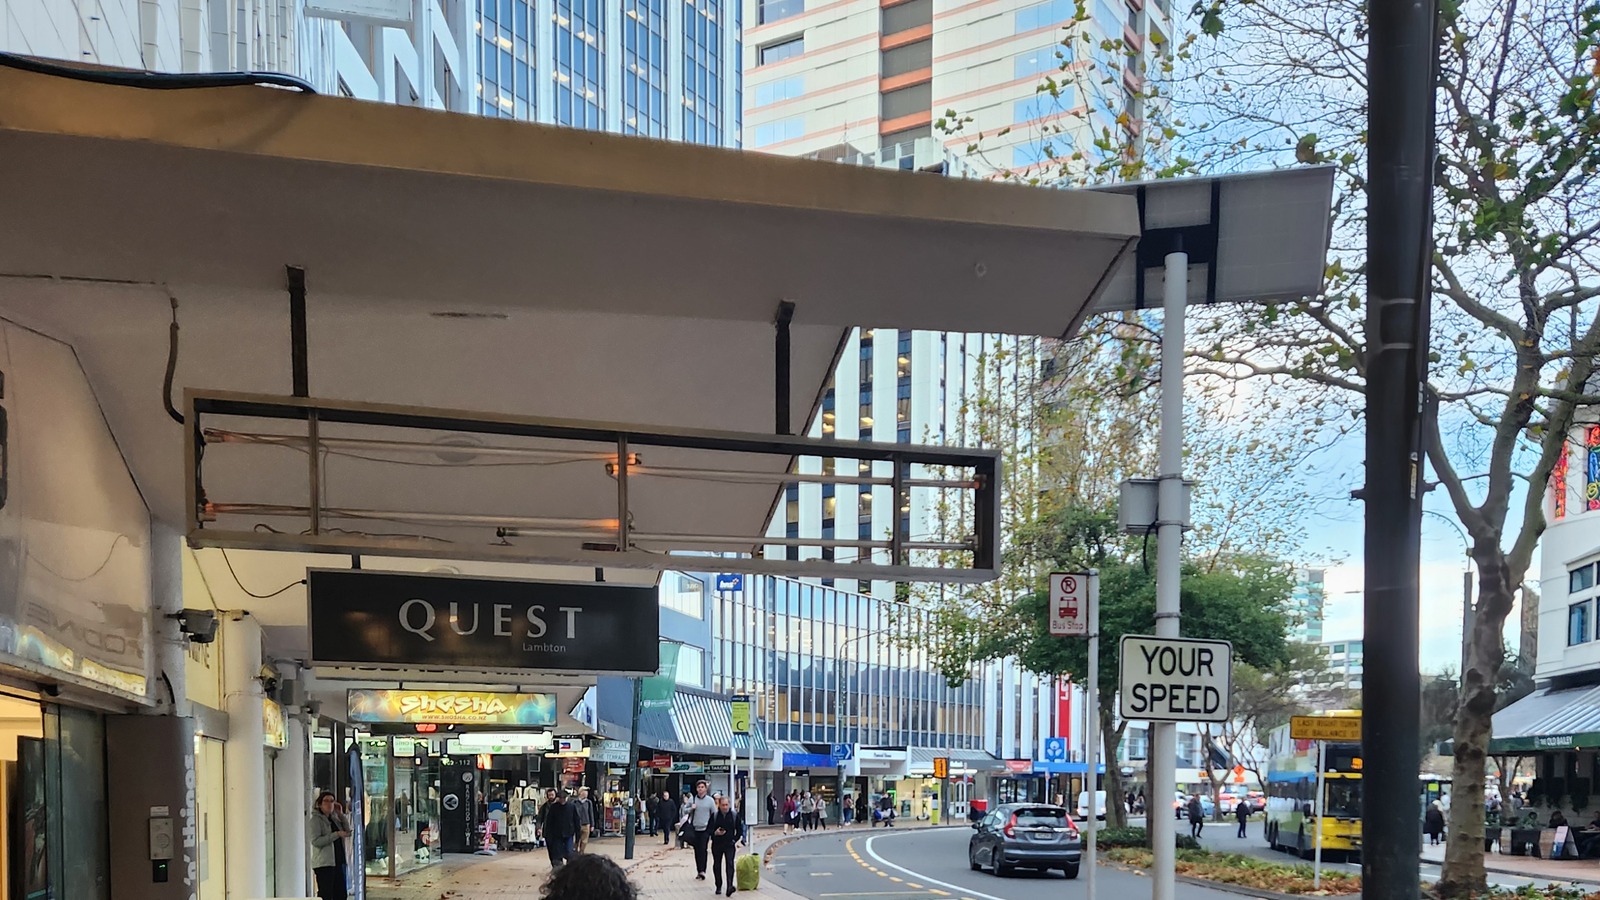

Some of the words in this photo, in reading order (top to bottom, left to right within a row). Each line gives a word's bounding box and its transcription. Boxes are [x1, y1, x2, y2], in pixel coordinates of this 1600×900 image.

[398, 599, 583, 641] QUEST
[1052, 620, 1066, 630] Bus
[1067, 621, 1084, 631] Stop
[522, 641, 566, 653] Lambton
[1140, 645, 1214, 676] YOUR
[1130, 683, 1220, 714] SPEED
[736, 720, 744, 731] C
